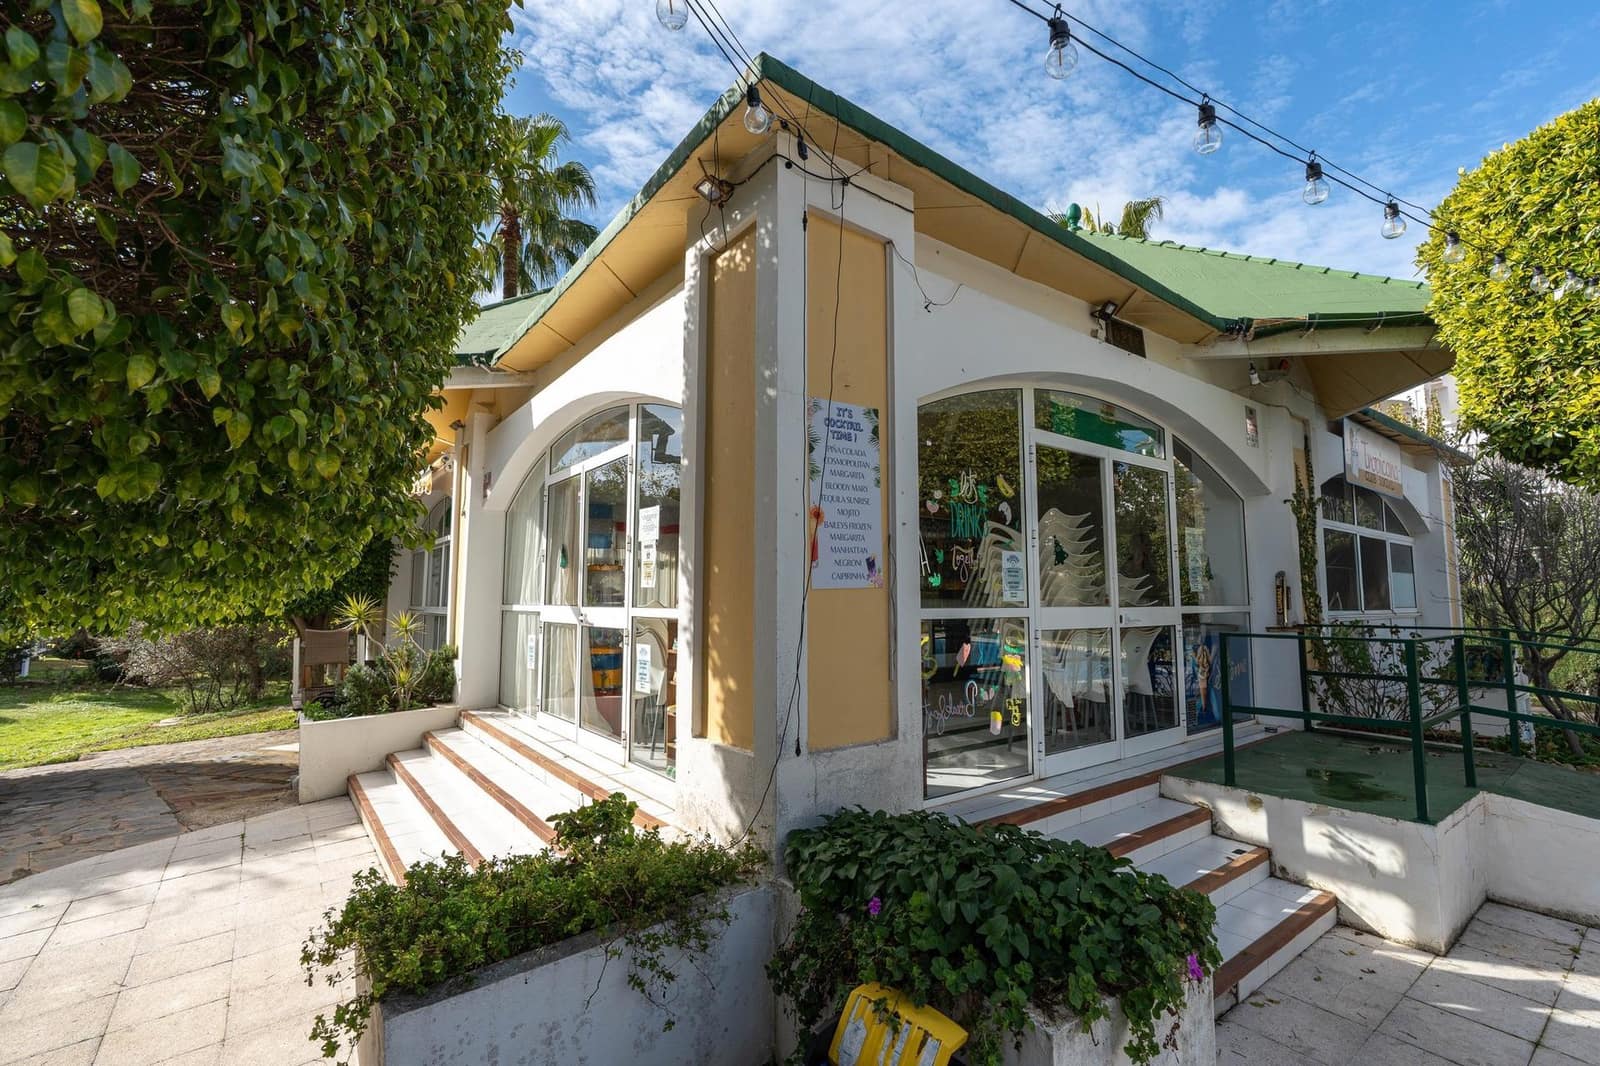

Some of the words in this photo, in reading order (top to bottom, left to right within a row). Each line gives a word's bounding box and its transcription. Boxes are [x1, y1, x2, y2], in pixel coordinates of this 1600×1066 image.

[837, 407, 853, 419] IT'S
[824, 417, 863, 432] COCKTAIL
[842, 447, 867, 457] COLADA
[830, 469, 865, 480] MARGARITA
[825, 481, 851, 491] BLOODY
[851, 484, 868, 493] MARY
[821, 494, 846, 504] TEQUILA
[846, 496, 871, 506] SUNRISE
[837, 508, 860, 518] MOJITO
[824, 520, 849, 530] BAILEYS
[849, 521, 872, 531] FROZEN
[830, 533, 866, 542] MARGARITA
[830, 545, 868, 554] MANHATTAN
[834, 559, 862, 567] NEGRONI
[831, 572, 866, 580] CAIPIRINHA
